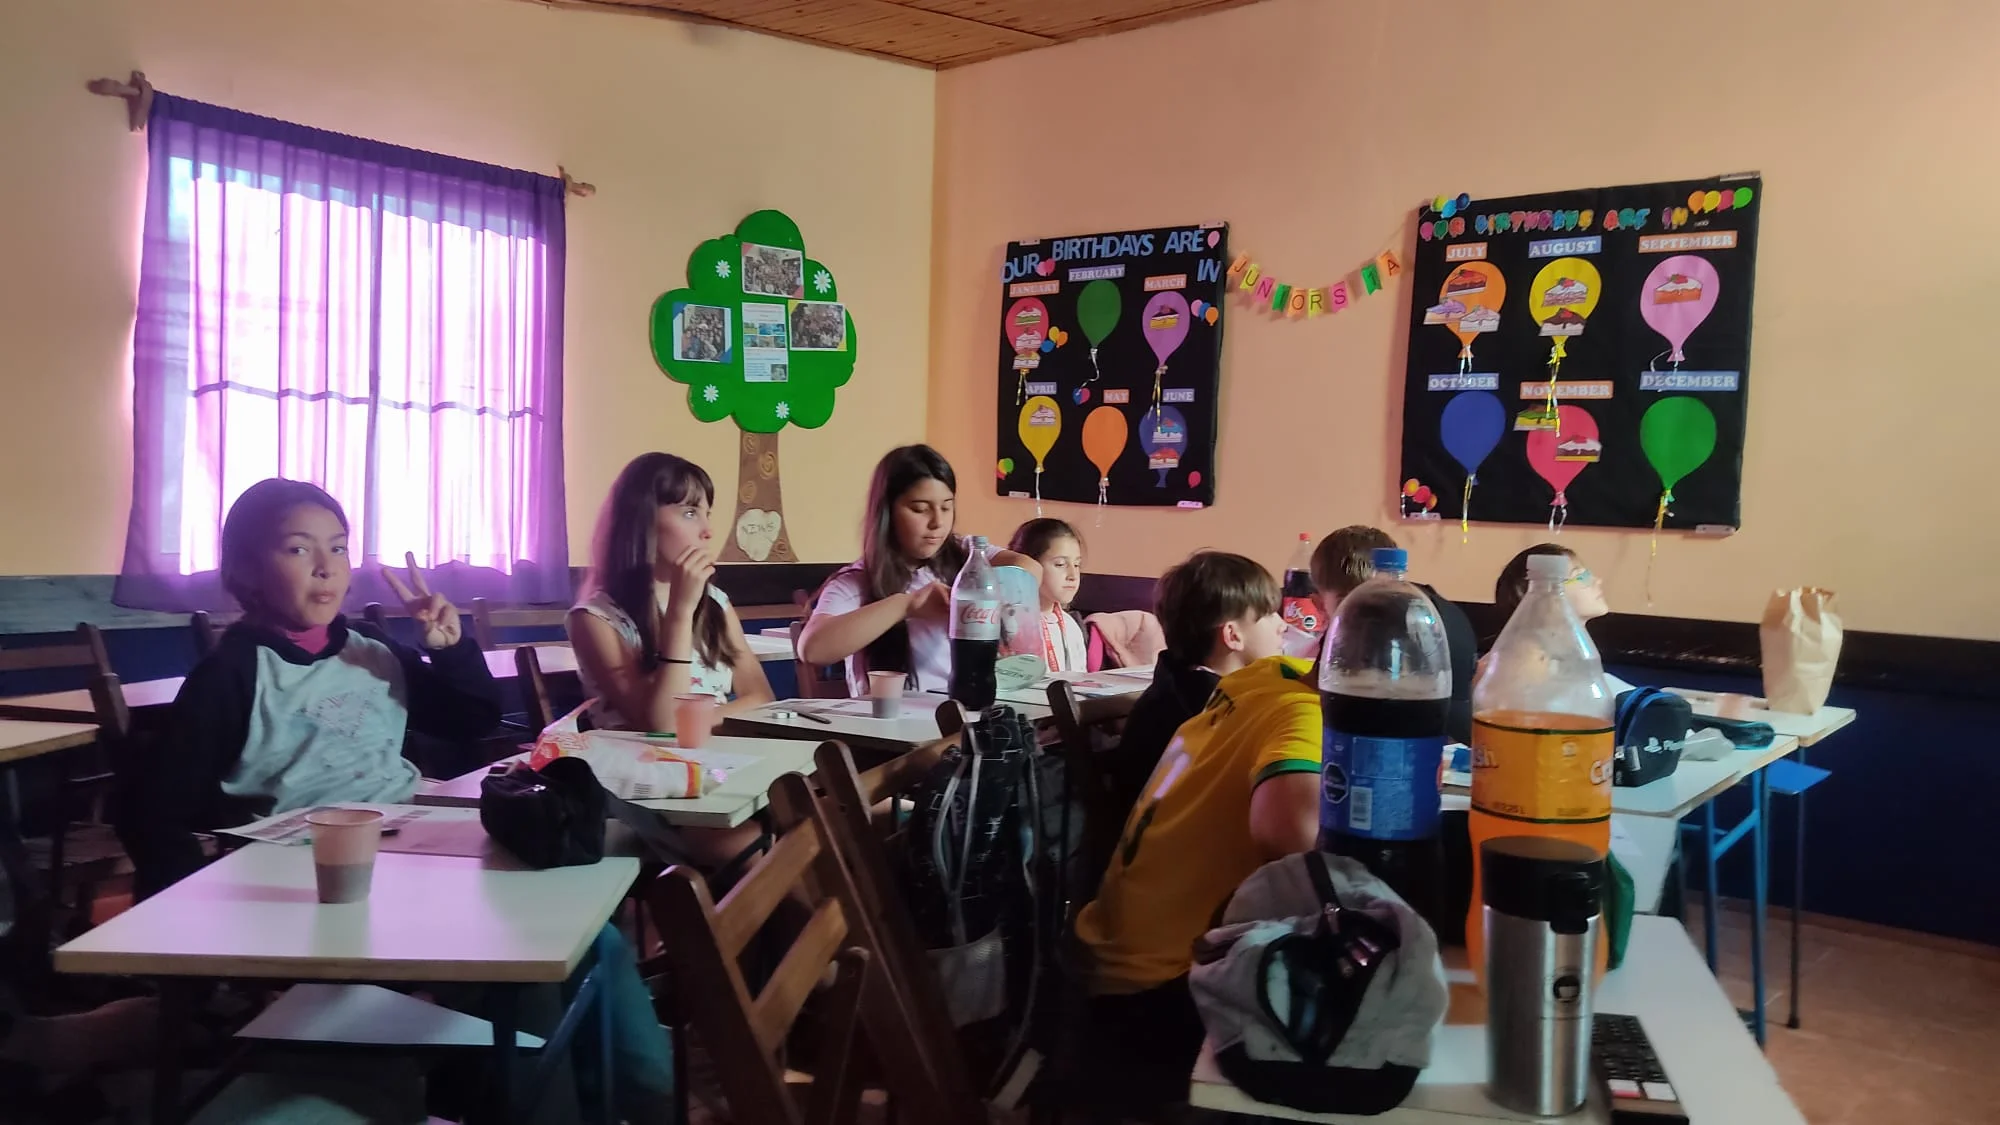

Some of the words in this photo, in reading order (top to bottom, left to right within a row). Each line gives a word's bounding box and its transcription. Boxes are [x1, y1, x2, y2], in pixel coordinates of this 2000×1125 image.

[1529, 239, 1598, 257] AUGUST
[1639, 234, 1734, 251] SEPTEMBER
[1001, 252, 1041, 284] OUR
[1051, 233, 1154, 261] BIRTHDAYS
[1163, 229, 1205, 255] ARE
[1446, 245, 1487, 259] JULY
[1069, 266, 1125, 281] FEBRUARY
[1197, 258, 1222, 283] IN
[1010, 283, 1059, 296] JANUARY
[1145, 276, 1185, 290] MARCH
[1234, 260, 1347, 311] JUNIORS
[1428, 376, 1498, 390] OCTOBER
[1640, 374, 1737, 388] DECEMBER
[1026, 384, 1056, 395] APRIL
[1164, 391, 1195, 402] JUNE
[1521, 384, 1610, 398] NOVEMBER
[1104, 392, 1128, 403] MAY
